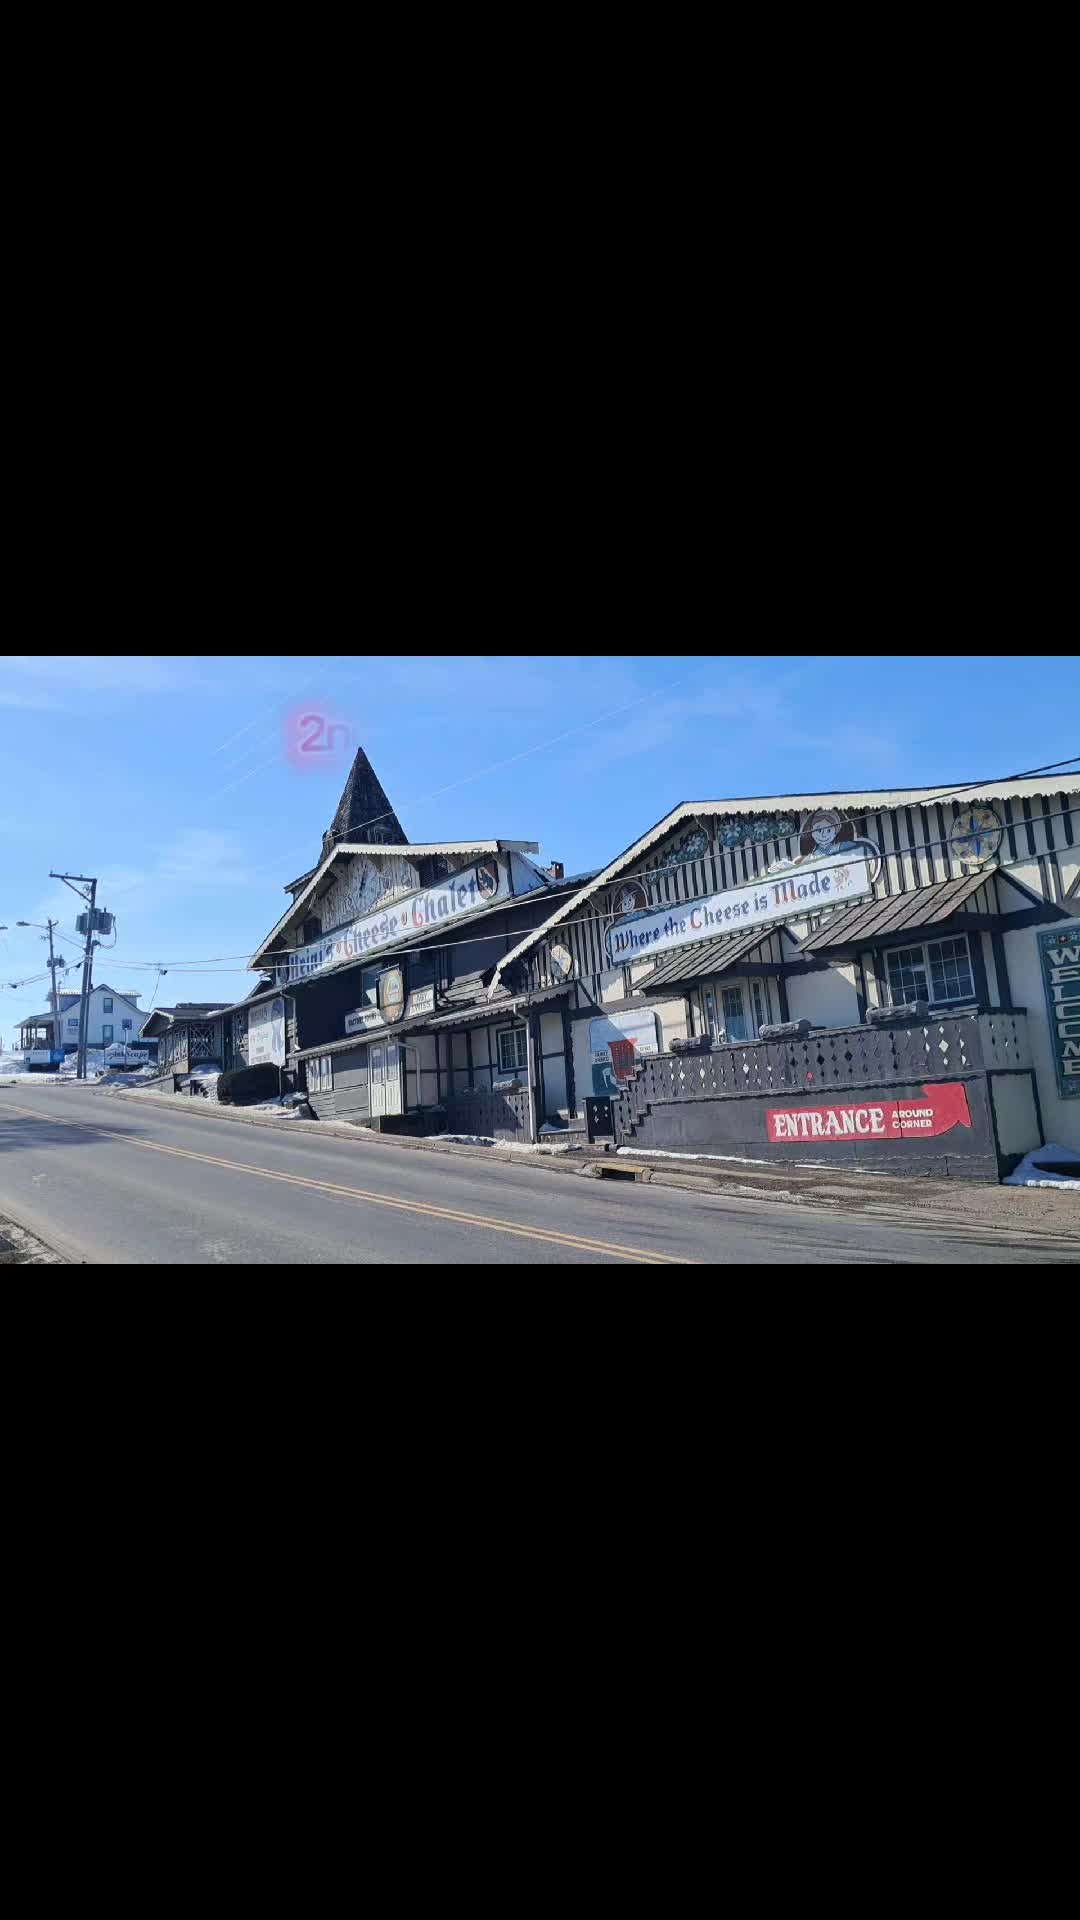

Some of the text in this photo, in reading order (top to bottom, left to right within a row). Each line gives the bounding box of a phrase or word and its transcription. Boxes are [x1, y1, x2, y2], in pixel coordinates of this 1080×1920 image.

[343, 913, 398, 960] Cheese
[411, 876, 477, 929] Chalet
[614, 870, 832, 953] Where the Cheese is Made
[773, 1108, 934, 1137] ENTRANCE AROUND
[891, 1119, 933, 1129] CORNER
